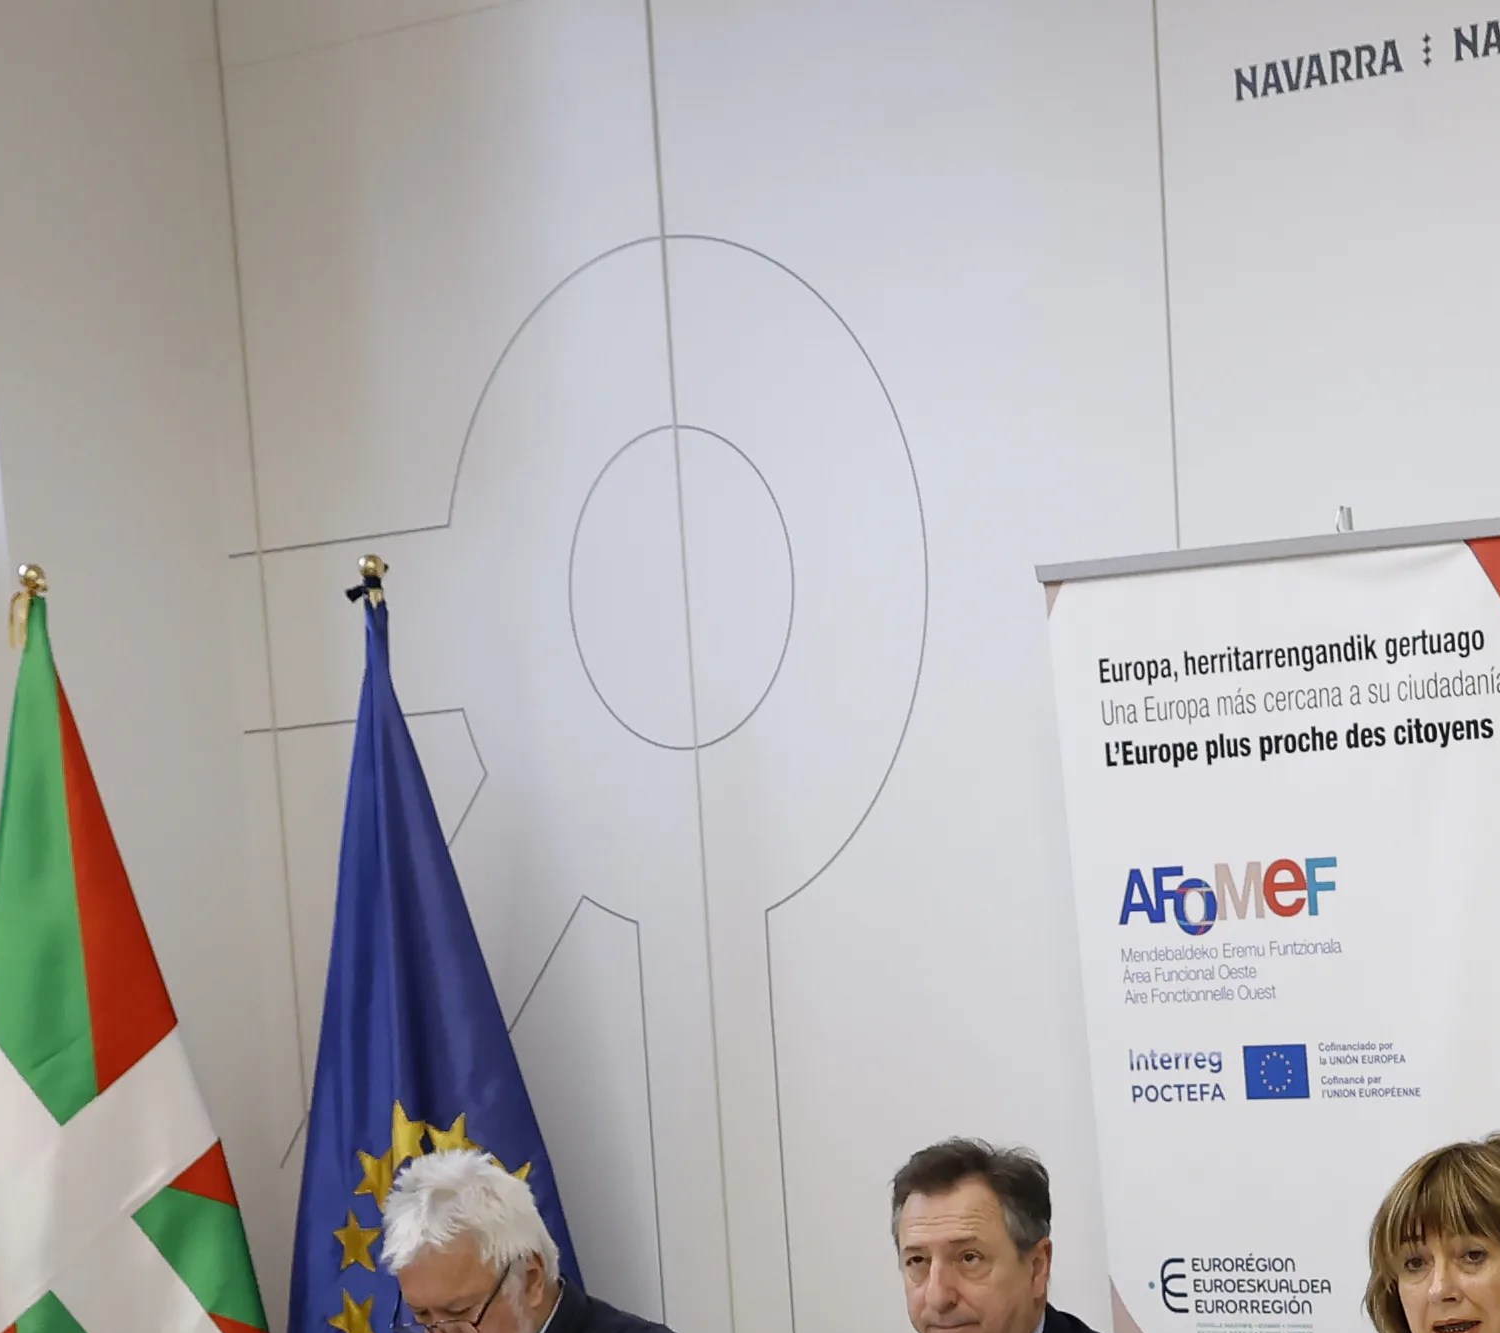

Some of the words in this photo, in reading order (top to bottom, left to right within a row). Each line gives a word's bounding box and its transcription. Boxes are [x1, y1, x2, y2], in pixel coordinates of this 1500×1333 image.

[1234, 38, 1403, 102] NAVARRA
[1099, 650, 1179, 684] Europa,
[1183, 634, 1377, 677] herritarrengandik
[1385, 628, 1485, 664] gertuago
[1101, 697, 1139, 726] Una
[1144, 694, 1210, 726] Europa
[1217, 688, 1257, 717] más
[1263, 685, 1343, 714] cercana
[1349, 683, 1362, 707] a
[1367, 680, 1391, 706] su
[1206, 728, 1252, 764] plus
[1259, 723, 1338, 760] proche
[1345, 722, 1386, 749] des
[1393, 717, 1494, 750] citoyens
[1121, 946, 1218, 963] Mendebaldeko
[1222, 943, 1265, 959] Eremu
[1269, 939, 1342, 956] Funtzionala
[1123, 965, 1151, 984] Área
[1154, 965, 1214, 982] Funcional
[1219, 964, 1257, 979] Oeste
[1125, 989, 1148, 1004] Aire
[1151, 986, 1234, 1003] Fonctionnelle
[1237, 985, 1276, 1000] Ouest
[1318, 1042, 1376, 1052] Cofinanciado
[1378, 1043, 1393, 1053] por
[1129, 1049, 1222, 1073] Interreg
[1319, 1056, 1327, 1065] la
[1329, 1053, 1358, 1066] UNIÓN
[1361, 1053, 1405, 1064] EUROPEA
[1321, 1075, 1365, 1086] Cofinancé
[1367, 1077, 1381, 1087] par
[1131, 1083, 1225, 1103] POCTEFA
[1359, 1085, 1420, 1098] EUROPÉENNE
[1191, 1253, 1296, 1273] EURORÉGION
[1193, 1279, 1332, 1294] EUROESKUALDEA
[1195, 1296, 1313, 1315] EURORREGIÓN
